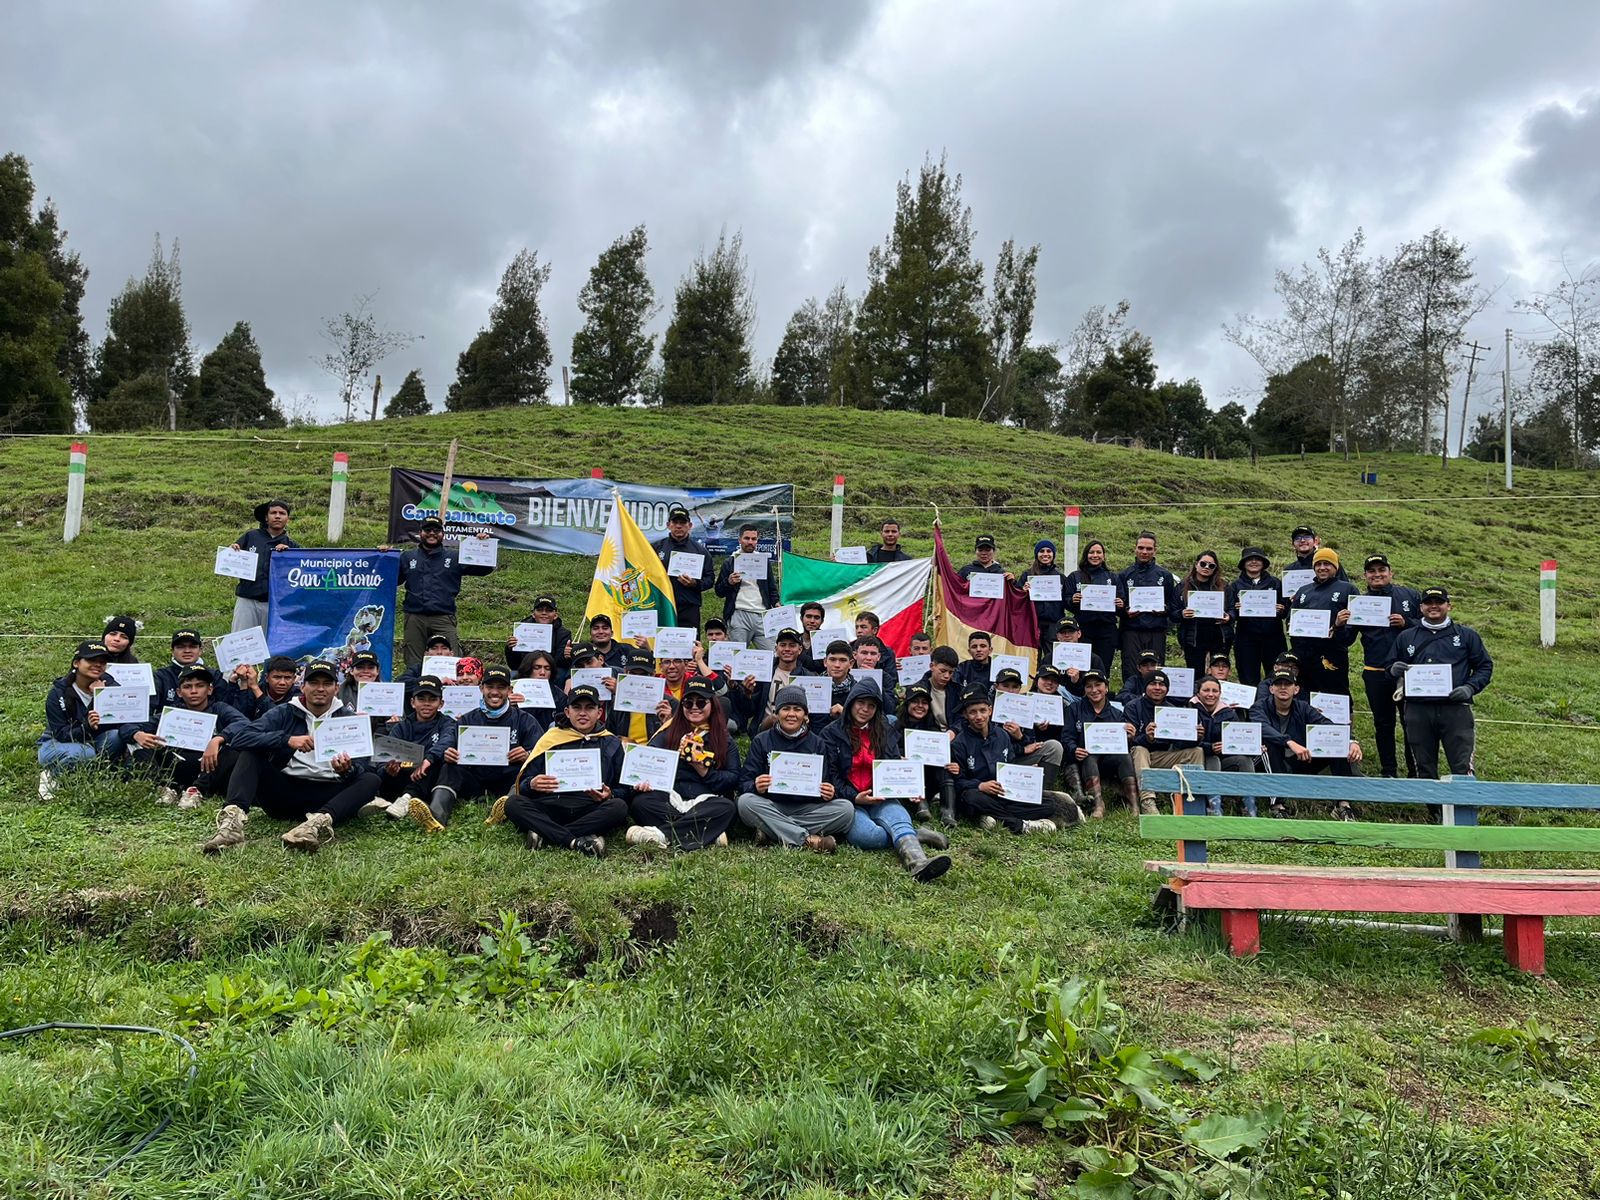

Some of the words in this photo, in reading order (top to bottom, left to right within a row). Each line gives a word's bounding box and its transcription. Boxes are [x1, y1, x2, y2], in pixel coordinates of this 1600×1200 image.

[528, 497, 682, 531] BIENVEIDO
[442, 525, 494, 534] ARTAMENTAL
[300, 558, 352, 569] Municipio
[354, 558, 369, 568] de
[288, 567, 321, 588] San
[321, 568, 384, 591] Antonio
